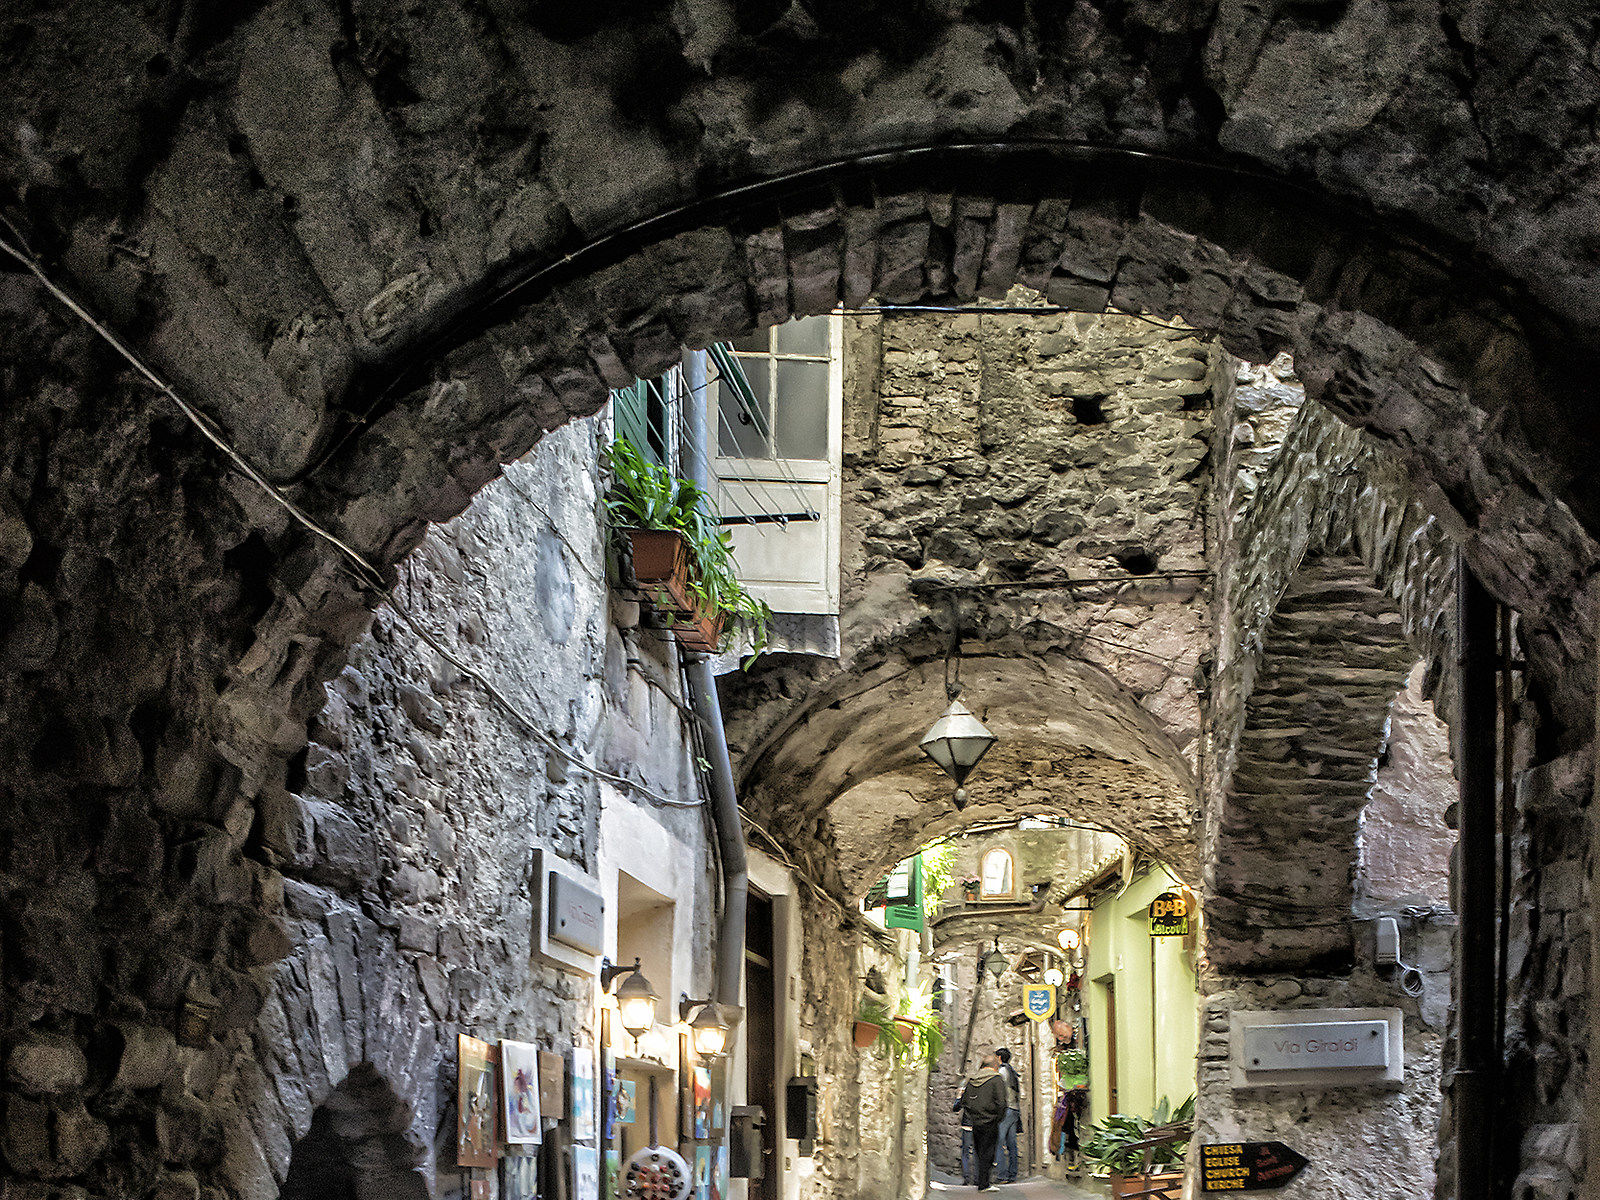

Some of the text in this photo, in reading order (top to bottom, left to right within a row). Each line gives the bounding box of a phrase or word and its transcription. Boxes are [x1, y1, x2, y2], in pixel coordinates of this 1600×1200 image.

[1154, 899, 1187, 916] B&B
[1273, 1038, 1358, 1054] Via Giraldi
[1204, 1145, 1243, 1155] CHIESA
[1205, 1156, 1240, 1167] EGLISE
[1205, 1167, 1250, 1178] CHURCH
[1206, 1179, 1245, 1190] KIRCHE
